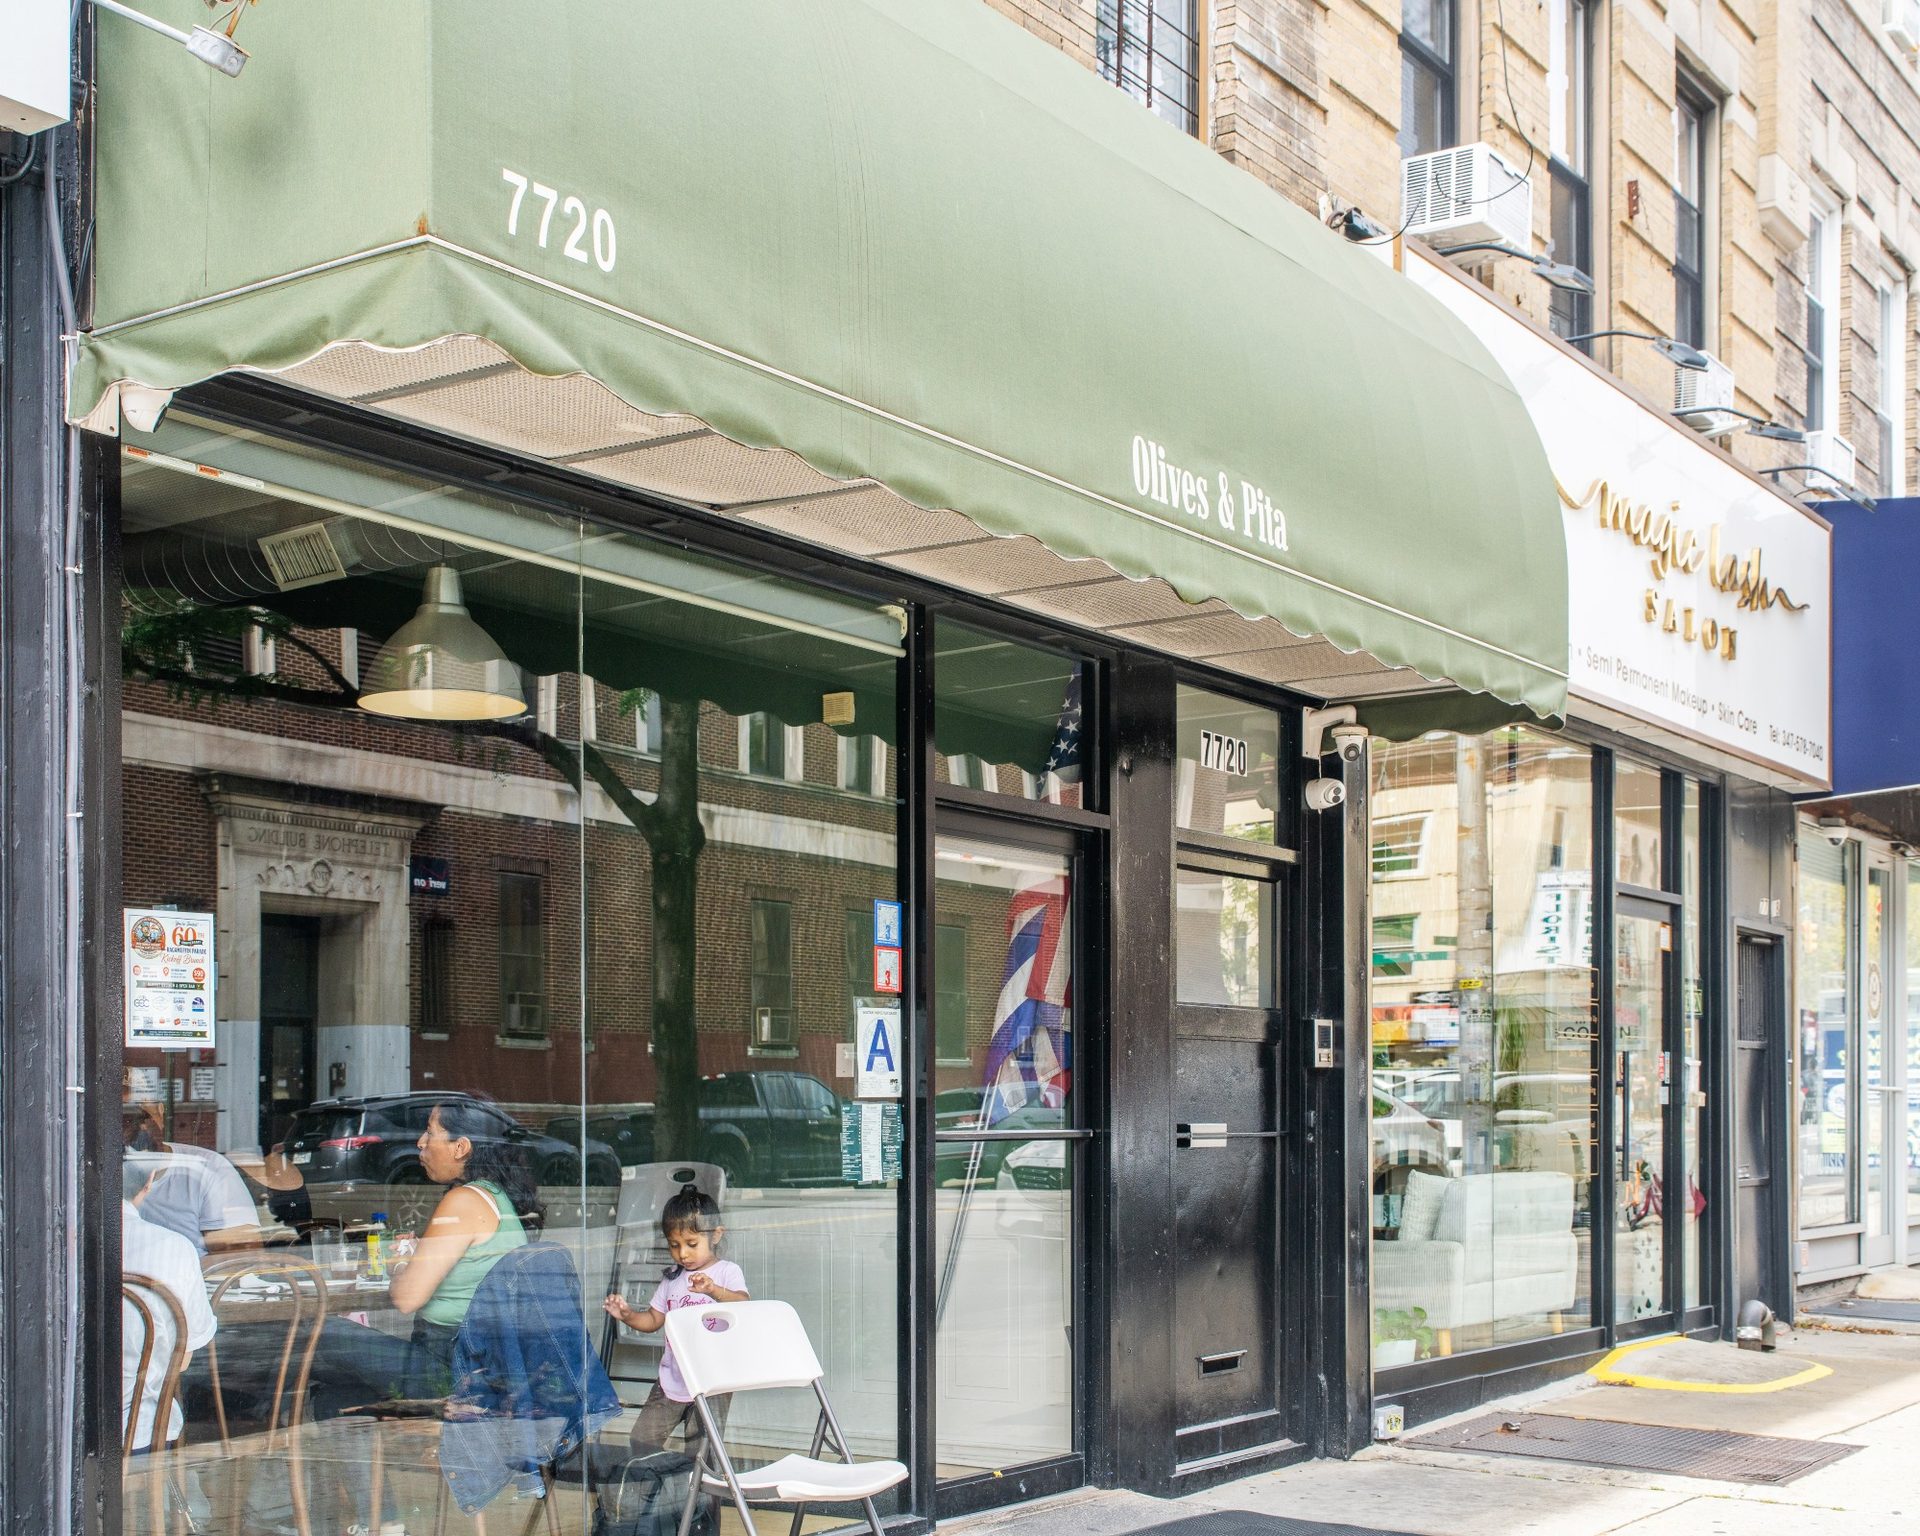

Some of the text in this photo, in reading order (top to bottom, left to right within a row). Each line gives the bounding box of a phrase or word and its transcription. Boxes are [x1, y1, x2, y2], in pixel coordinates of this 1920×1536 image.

[502, 168, 617, 273] 7720
[1132, 435, 1289, 552] Olives & Pita
[1709, 523, 1810, 611] lash
[1644, 588, 1738, 661] SALON
[1586, 645, 1613, 675] Semi
[1616, 659, 1669, 698] Permanent
[1671, 683, 1708, 715] Makeup
[1717, 702, 1735, 725] Skin
[1737, 710, 1758, 735] Care
[1202, 731, 1246, 776] 7720
[172, 926, 197, 946] 60
[865, 1019, 895, 1072] A
